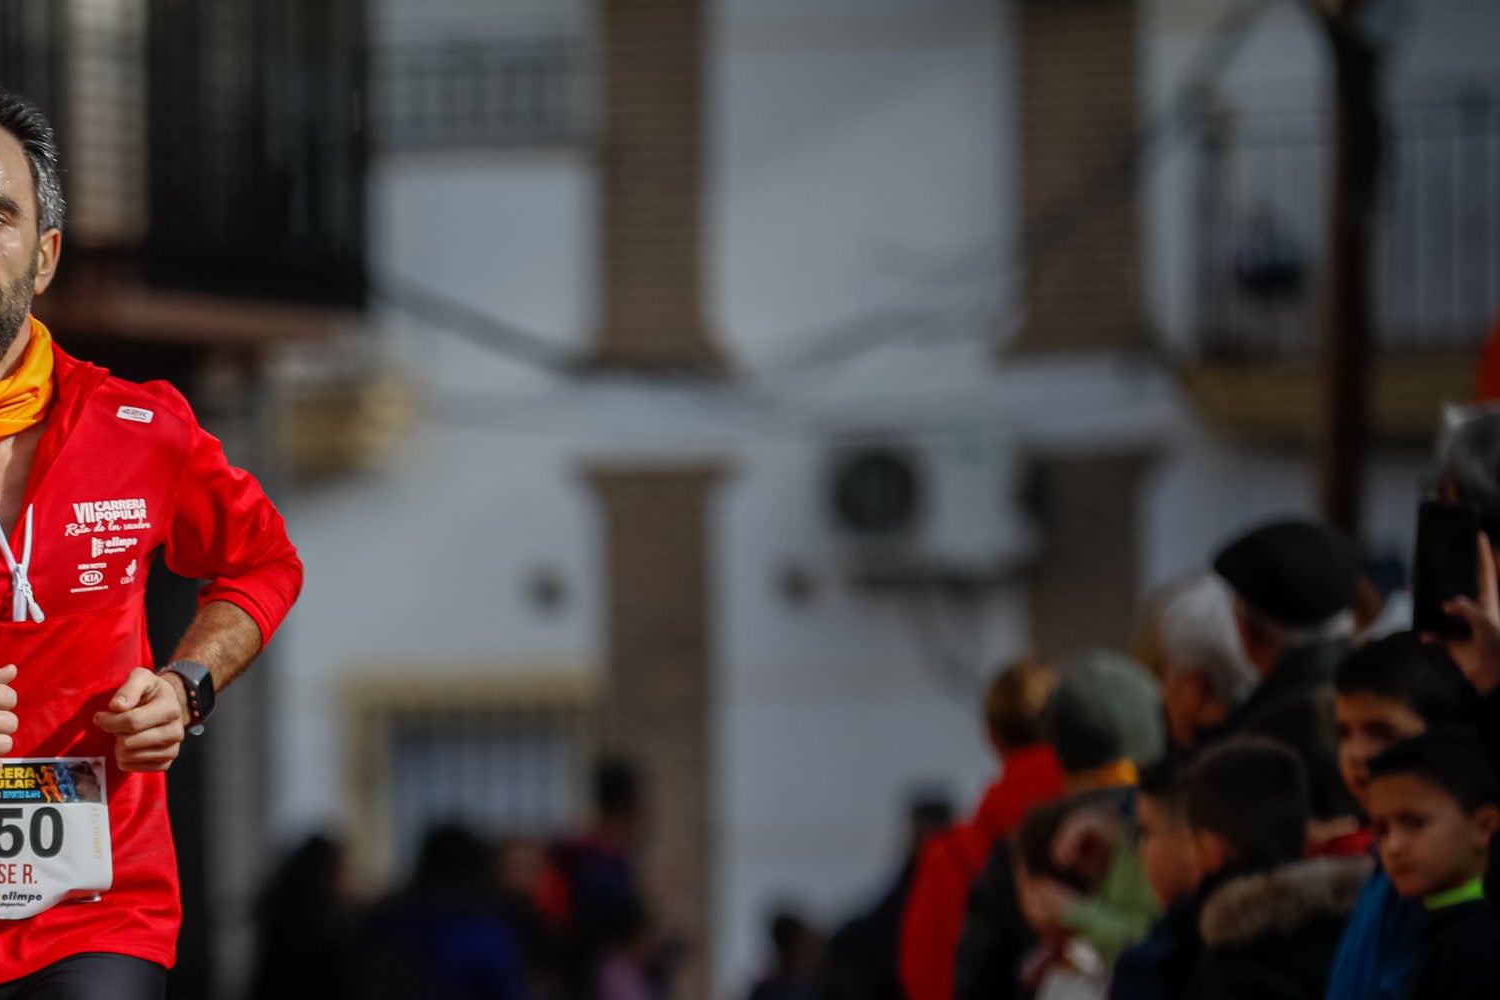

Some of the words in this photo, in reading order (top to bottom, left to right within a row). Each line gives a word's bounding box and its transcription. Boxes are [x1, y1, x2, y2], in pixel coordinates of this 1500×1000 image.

[95, 499, 146, 511] CARRERA
[73, 502, 95, 523] VII
[95, 509, 147, 522] POPULAR
[65, 523, 92, 537] Ruta
[93, 521, 106, 532] de
[22, 864, 38, 884] R.
[1, 890, 42, 903] olimpo
